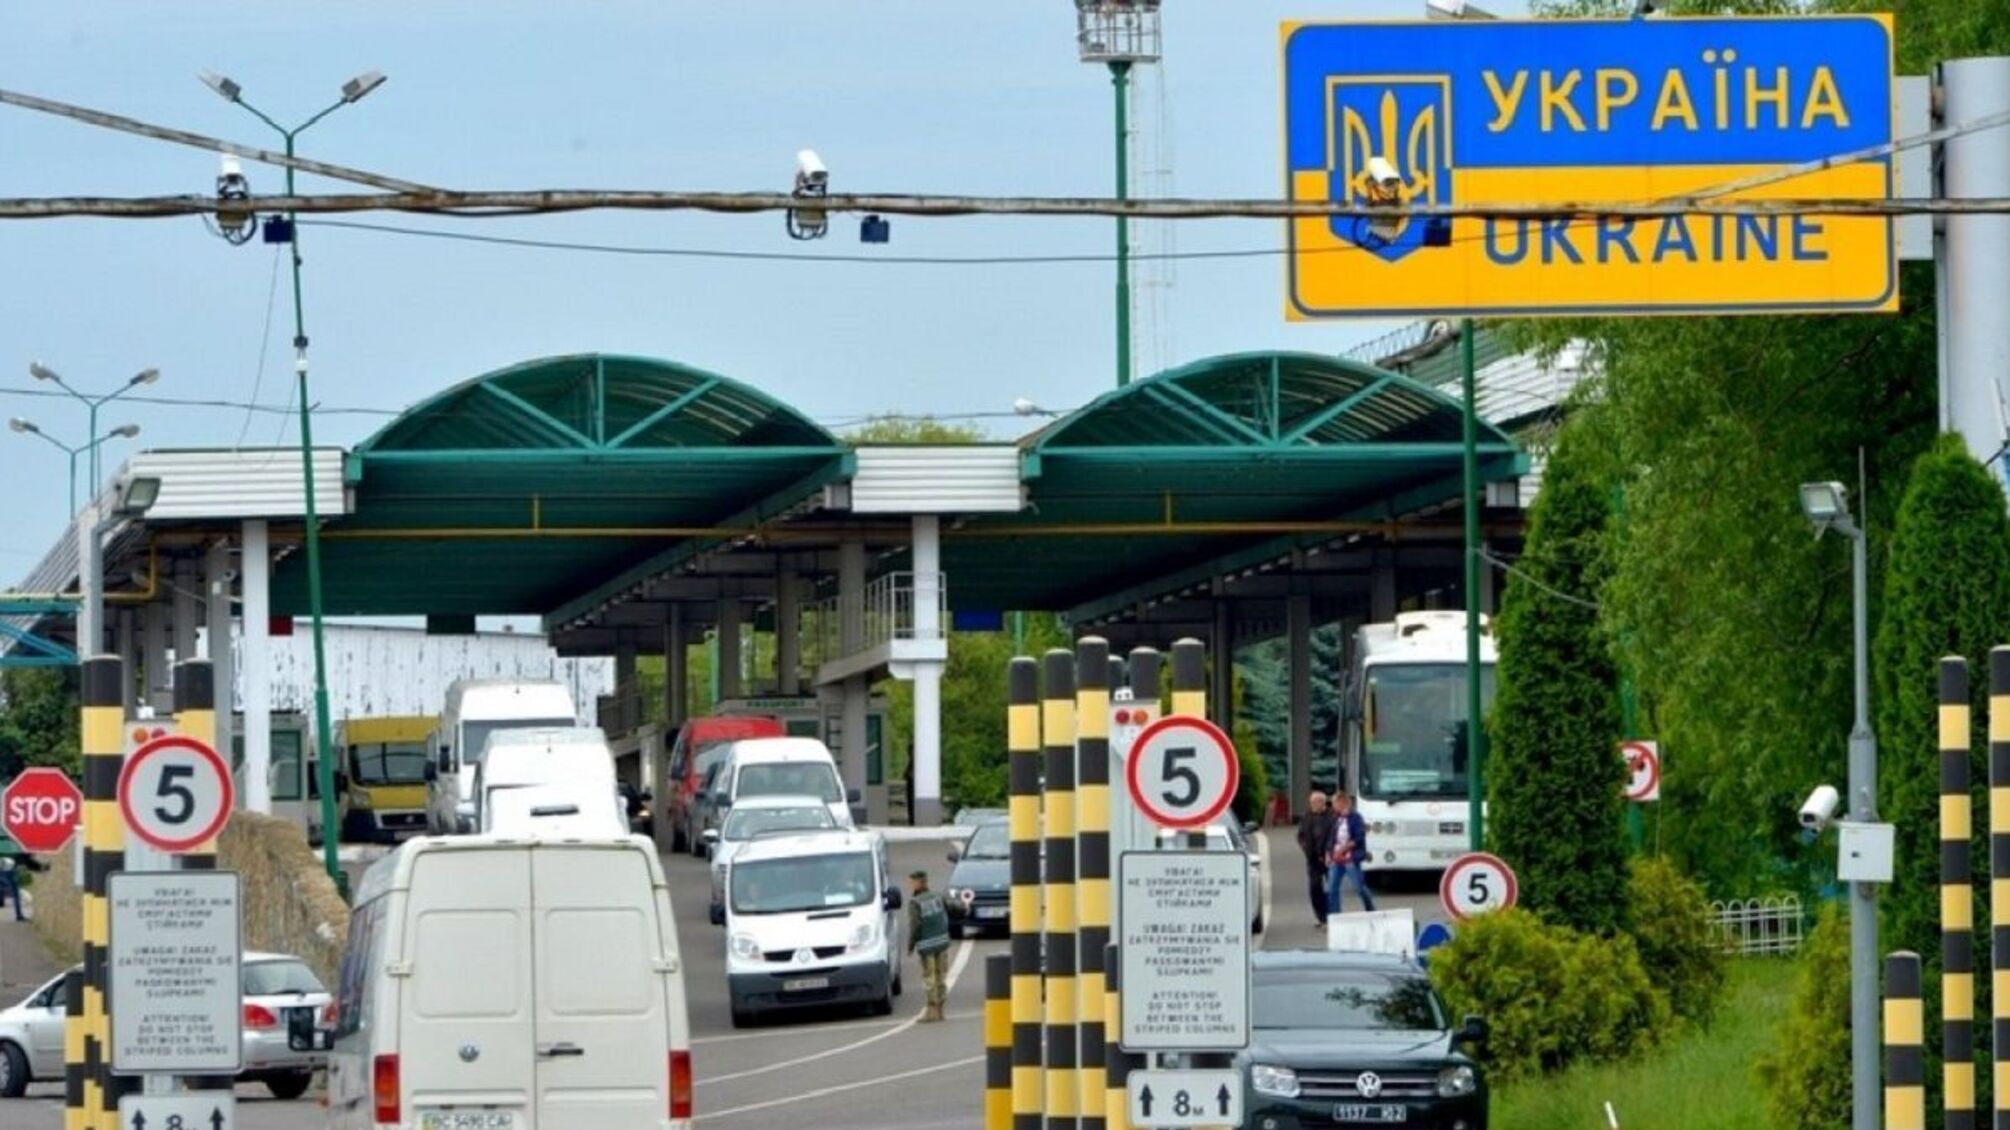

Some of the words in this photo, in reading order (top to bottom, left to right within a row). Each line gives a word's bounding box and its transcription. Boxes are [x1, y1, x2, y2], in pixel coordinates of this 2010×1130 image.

[1481, 49, 1850, 132] УКРАЇНА
[1484, 209, 1829, 265] UKRAINE
[1161, 747, 1200, 808] 5
[154, 764, 195, 825] 5
[10, 796, 75, 825] STOP
[1468, 872, 1488, 905] 5
[1142, 923, 1187, 935] UWAGA!
[1190, 923, 1225, 935] ZAKAZ
[1145, 1013, 1199, 1023] BETWEEN
[1203, 1013, 1223, 1023] THE
[1147, 1002, 1163, 1012] DO
[1166, 1001, 1190, 1012] NOT
[1194, 1001, 1222, 1012] STOP
[1134, 1024, 1182, 1034] STRIPED
[1184, 1024, 1236, 1034] COLUMNS
